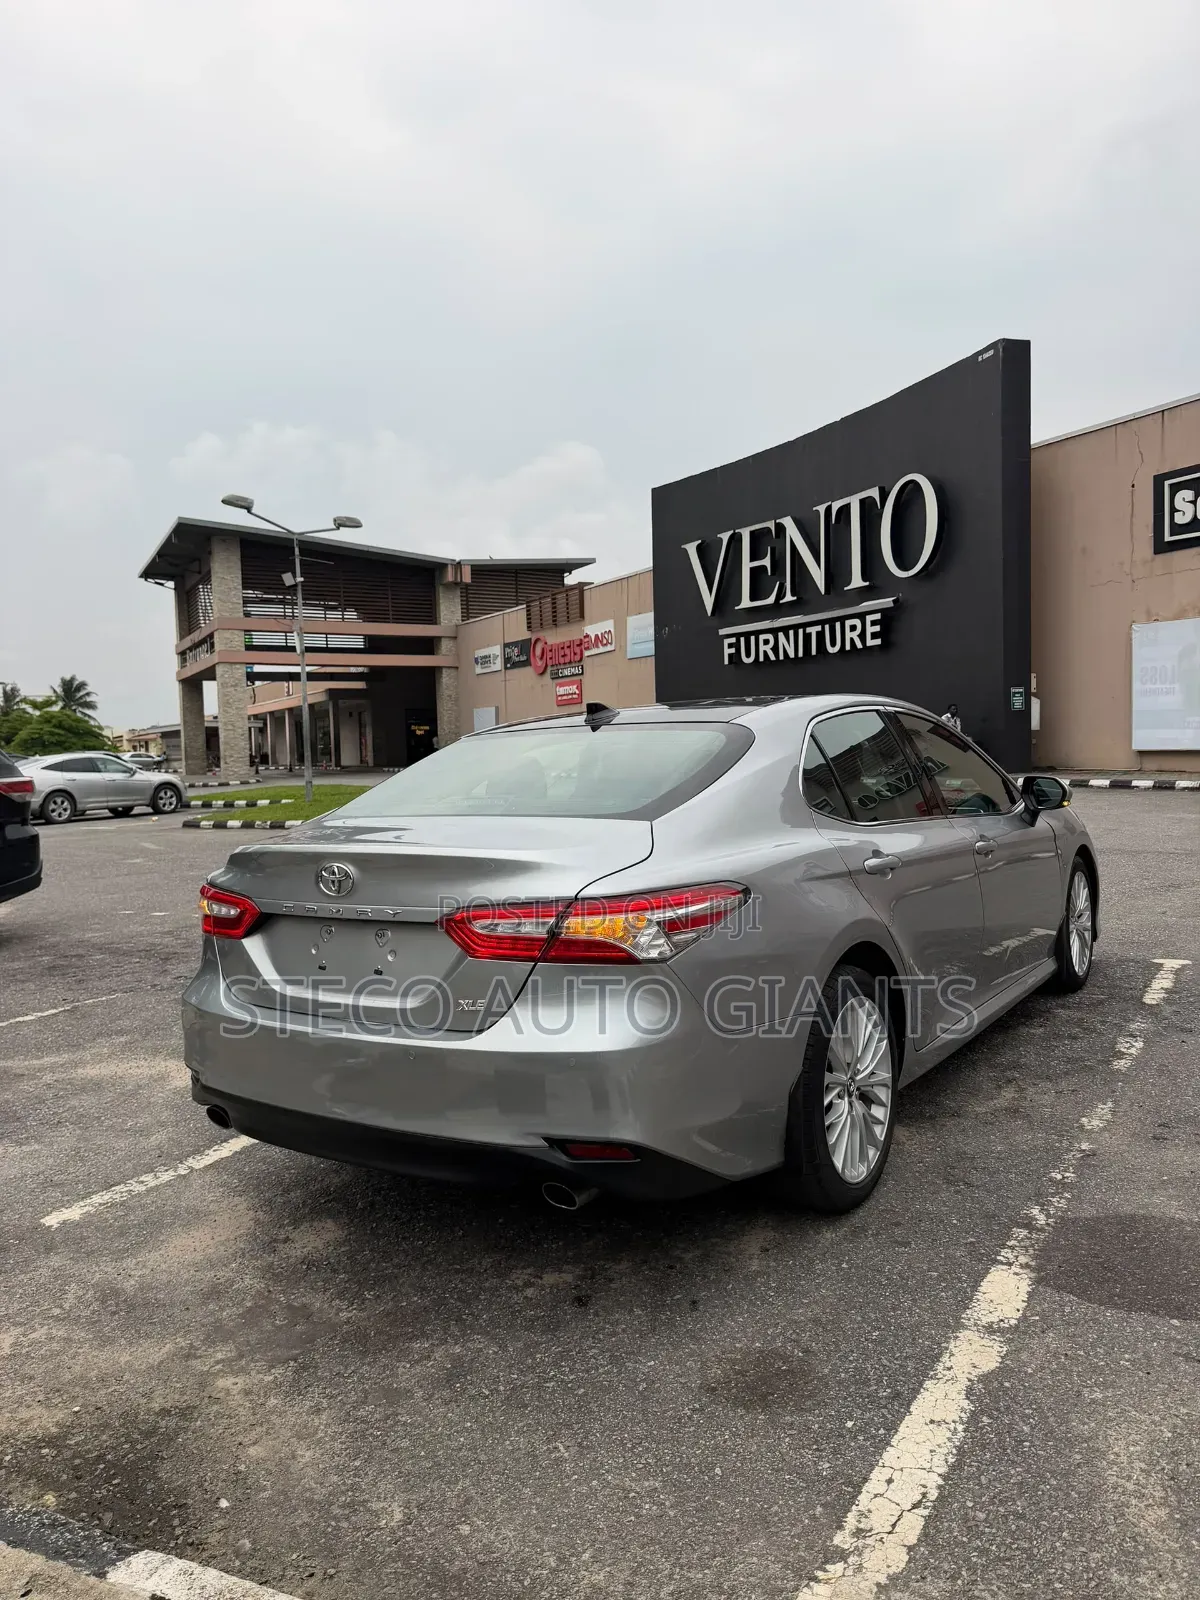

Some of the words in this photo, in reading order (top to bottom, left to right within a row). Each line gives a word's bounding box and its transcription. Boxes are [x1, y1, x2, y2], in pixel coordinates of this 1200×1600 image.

[1173, 489, 1200, 525] S
[681, 472, 939, 617] VENTO
[530, 635, 584, 675] GENESIS
[723, 612, 882, 665] FURNITURE
[558, 665, 582, 677] CINEMAS
[456, 999, 486, 1011] XLE
